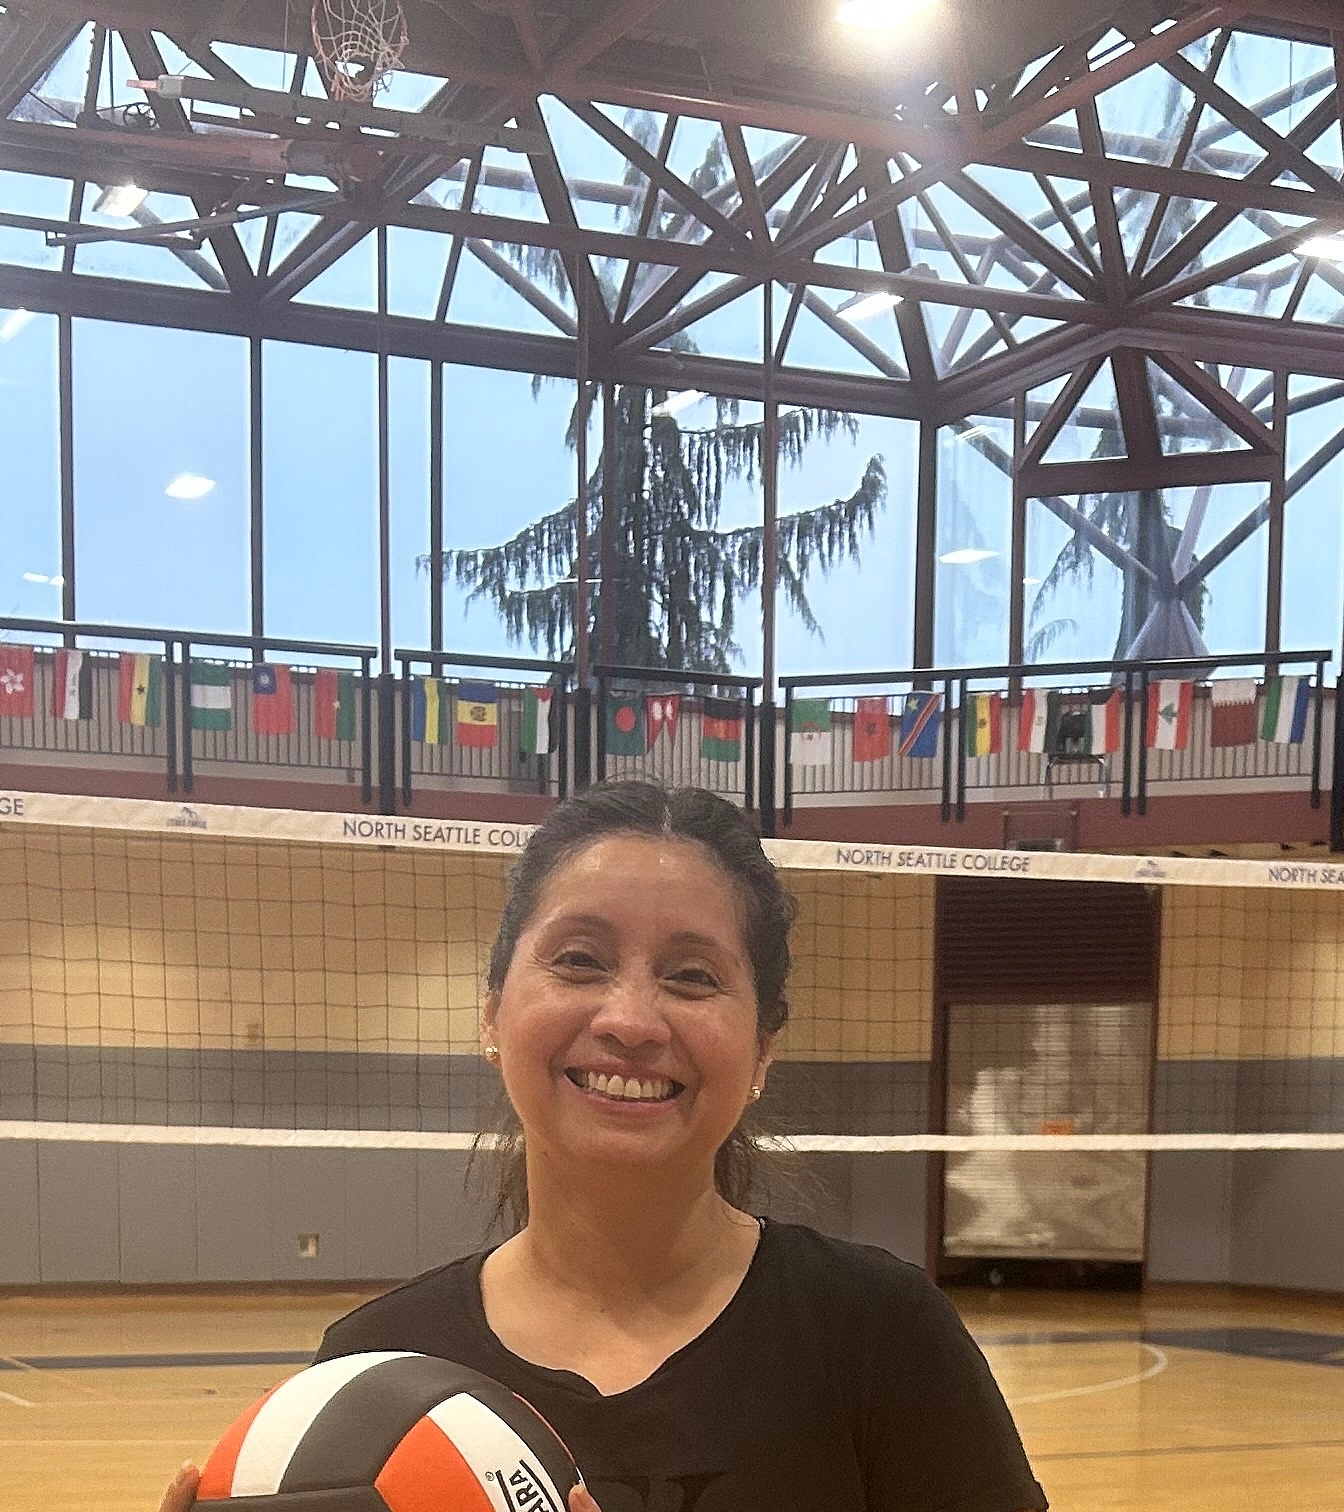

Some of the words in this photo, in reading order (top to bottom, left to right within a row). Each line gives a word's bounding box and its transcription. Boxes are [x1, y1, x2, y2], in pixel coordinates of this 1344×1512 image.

[343, 819, 406, 840] NORTH
[412, 825, 481, 845] SEATTLE
[836, 848, 892, 866] NORTH
[897, 852, 957, 869] SEATTLE
[962, 855, 1030, 872] COLLEGE
[1268, 867, 1316, 884] NORTH
